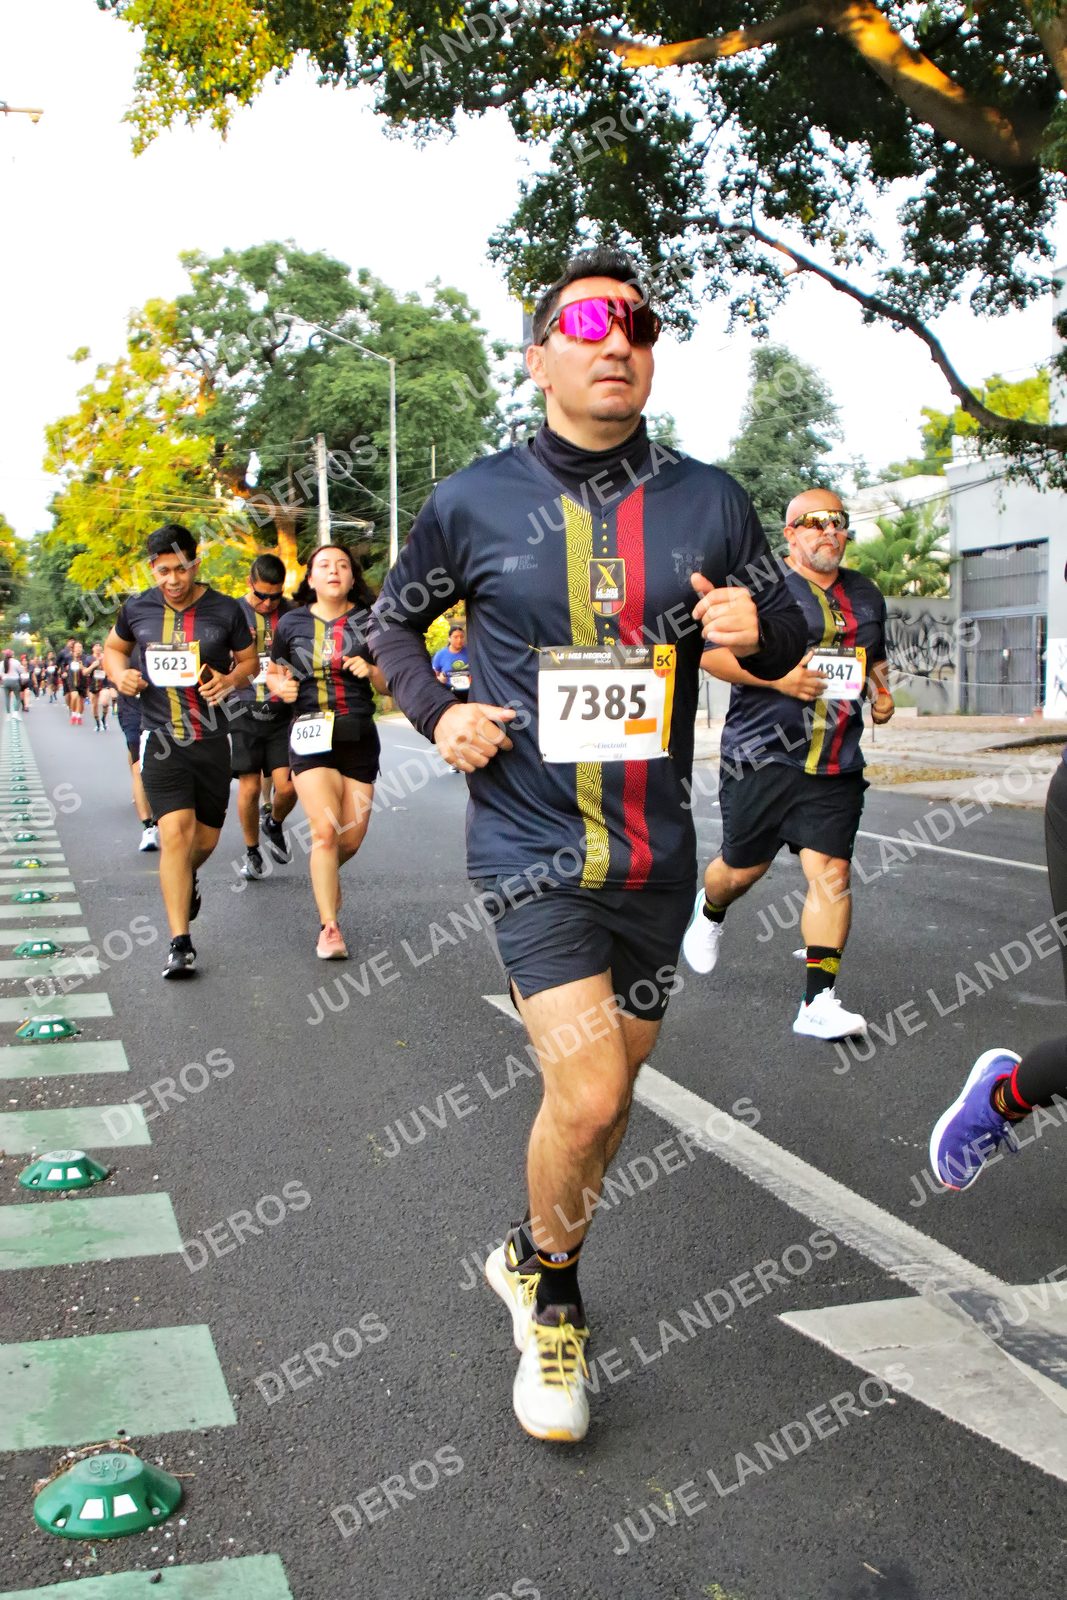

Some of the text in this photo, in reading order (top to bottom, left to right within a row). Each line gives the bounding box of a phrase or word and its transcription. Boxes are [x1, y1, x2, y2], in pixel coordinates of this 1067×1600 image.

[154, 656, 187, 670] 5623
[817, 663, 853, 680] 4847
[557, 684, 647, 721] 7385
[296, 724, 321, 740] 5622
